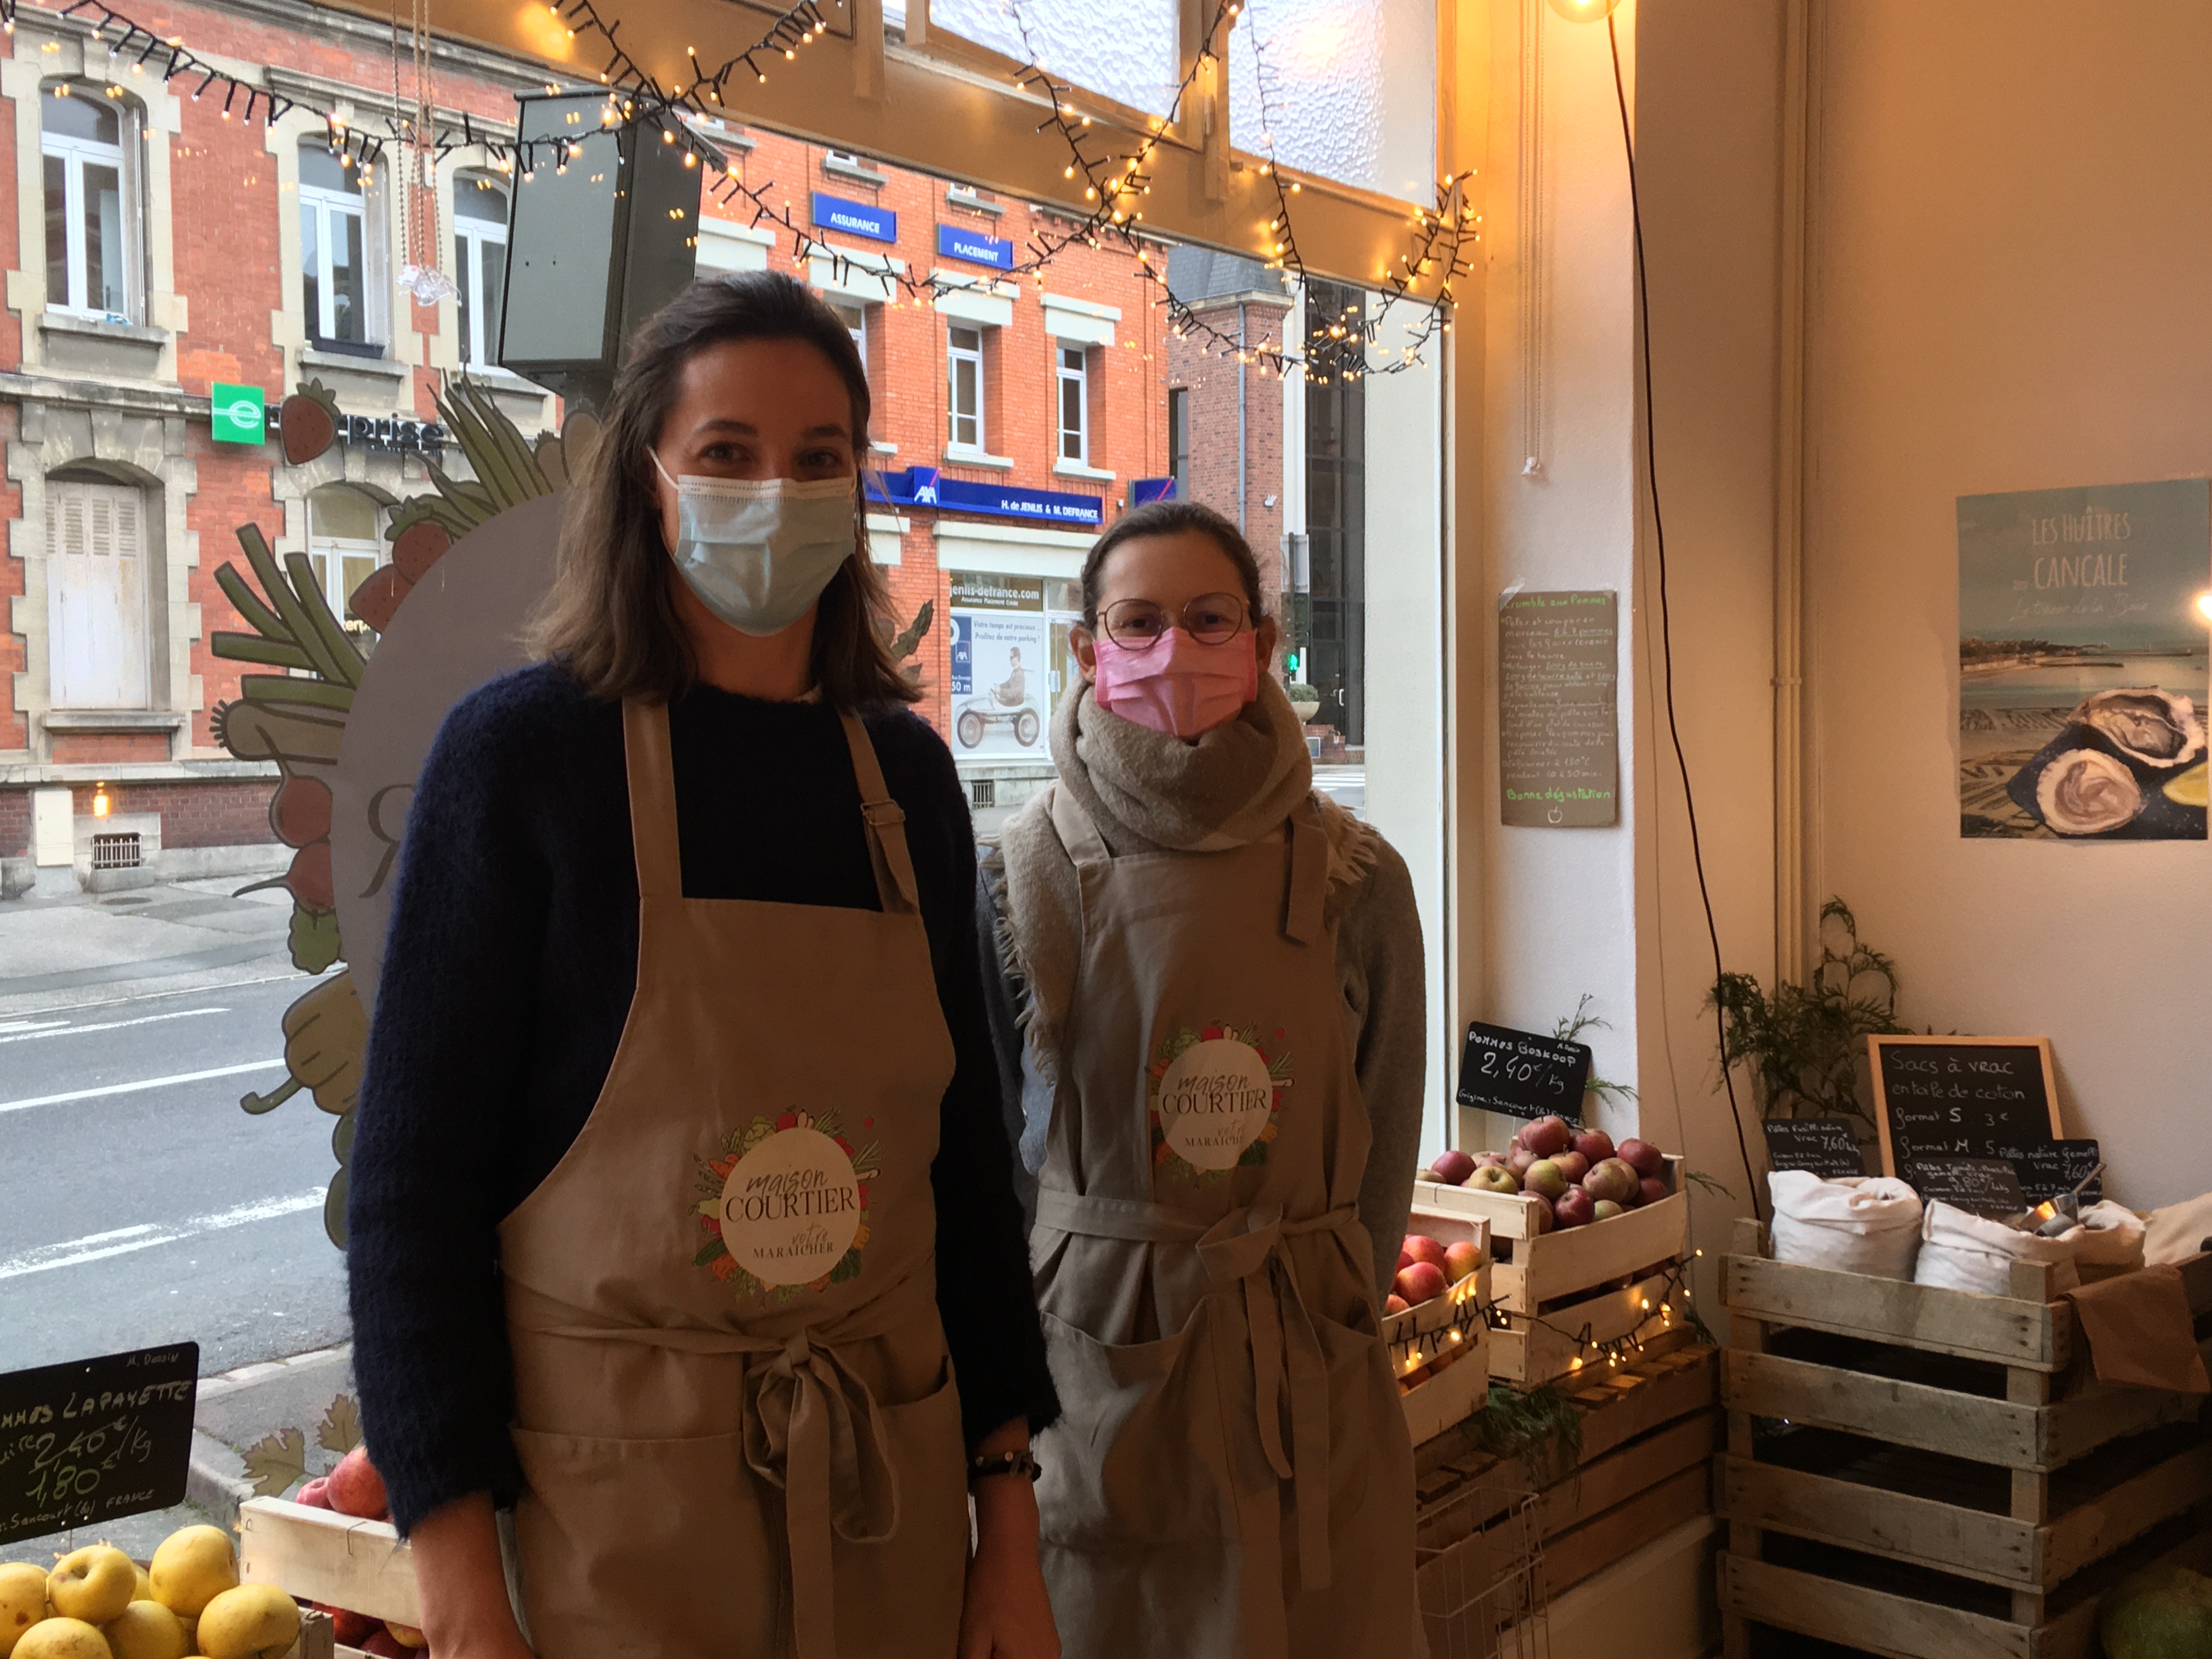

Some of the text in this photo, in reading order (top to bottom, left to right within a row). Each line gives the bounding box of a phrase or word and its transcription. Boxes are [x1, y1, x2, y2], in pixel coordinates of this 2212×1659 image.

[831, 212, 880, 234] ASSURANCE
[953, 241, 999, 262] PLACEMENT
[914, 485, 937, 505] AXA
[1011, 501, 1019, 510] de
[1020, 502, 1043, 512] JENLIS
[1045, 504, 1051, 515] &
[1063, 507, 1098, 519] DEFRANCE
[2032, 505, 2130, 544] LES HUÎTRES
[2034, 553, 2128, 590] CANCALE
[974, 620, 988, 629] Votre
[989, 622, 1004, 630] temps
[1014, 623, 1036, 631] précieux
[975, 632, 995, 640] Profitez
[1018, 634, 1037, 644] parking
[952, 681, 961, 692] 50
[1506, 788, 1543, 801] Bonne
[1891, 1050, 1939, 1074] Sacs
[1947, 1056, 1962, 1073] à
[1177, 1069, 1250, 1096] maison
[1948, 1083, 1968, 1099] de
[1976, 1084, 2025, 1100] coton
[1162, 1088, 1266, 1115] COURTIER
[1895, 1107, 1940, 1130] format
[1949, 1107, 1961, 1122] S
[1984, 1113, 1995, 1126] 3
[1900, 1136, 1949, 1159] format
[1954, 1138, 1970, 1153] M
[746, 1164, 828, 1201] maison
[725, 1186, 856, 1223] COURTIER
[106, 1489, 154, 1509] FRANCE
